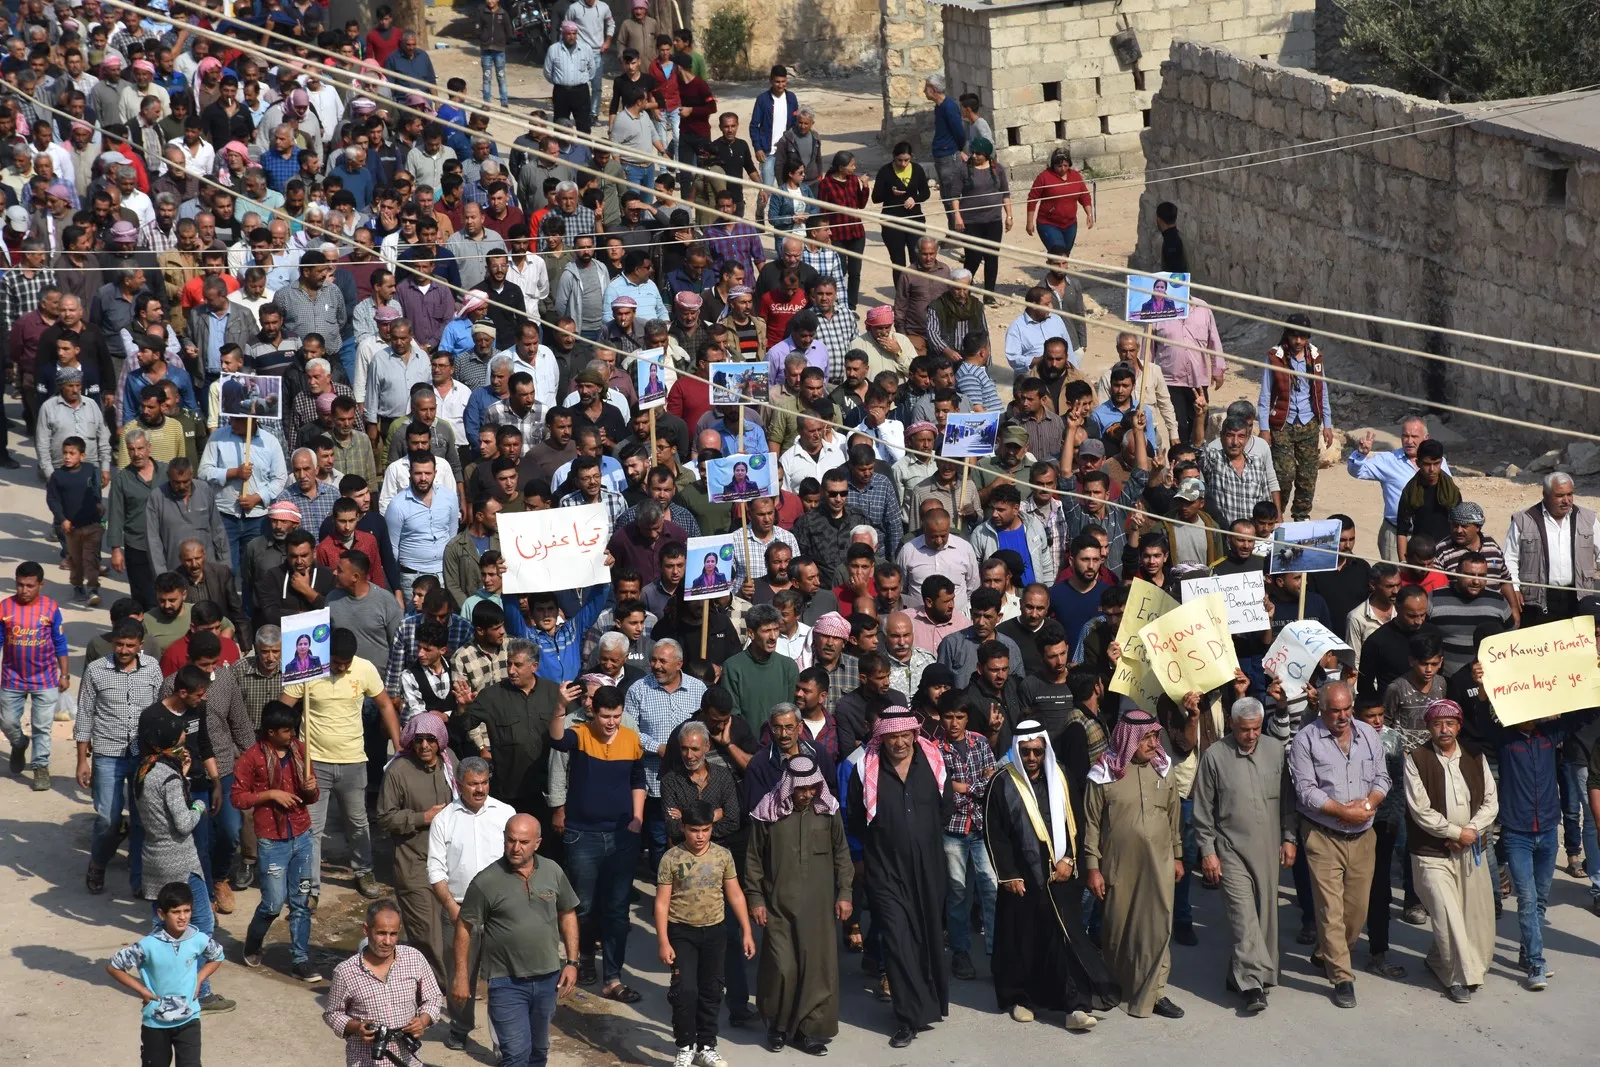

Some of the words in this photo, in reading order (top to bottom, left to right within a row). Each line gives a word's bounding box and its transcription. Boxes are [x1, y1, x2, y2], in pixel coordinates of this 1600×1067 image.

[515, 534, 570, 561] عفرين
[573, 521, 602, 554] تحيا
[1242, 573, 1264, 590] Azad
[12, 625, 40, 637] Qatar
[1147, 623, 1206, 656] Rojava
